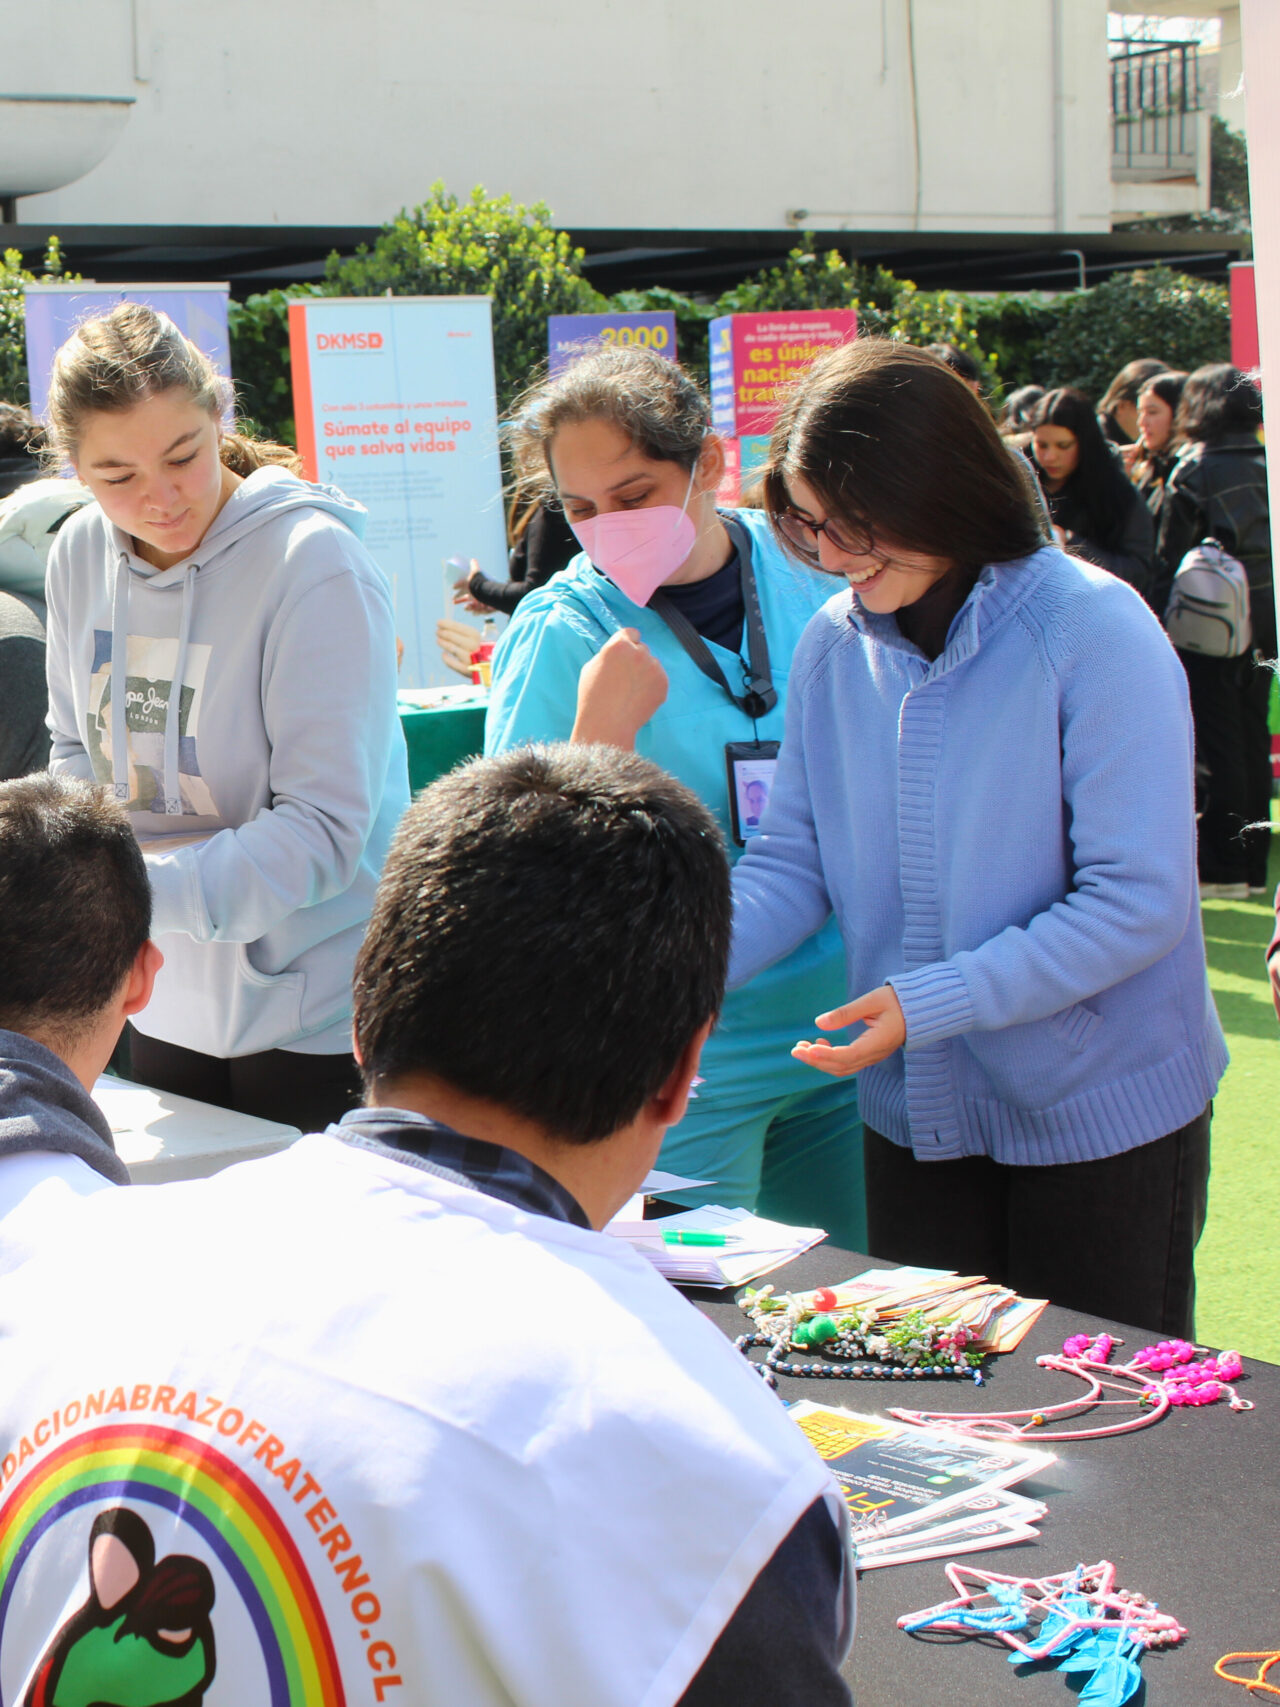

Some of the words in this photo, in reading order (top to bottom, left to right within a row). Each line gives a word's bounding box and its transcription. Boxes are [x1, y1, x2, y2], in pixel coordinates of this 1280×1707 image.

[316, 332, 368, 350] DKMS
[600, 325, 669, 351] 2000
[749, 347, 773, 362] es
[324, 420, 389, 437] Súmate
[394, 419, 409, 434] al
[414, 416, 472, 437] equipo
[325, 444, 356, 461] que
[360, 439, 405, 455] salva
[410, 437, 456, 453] vidas
